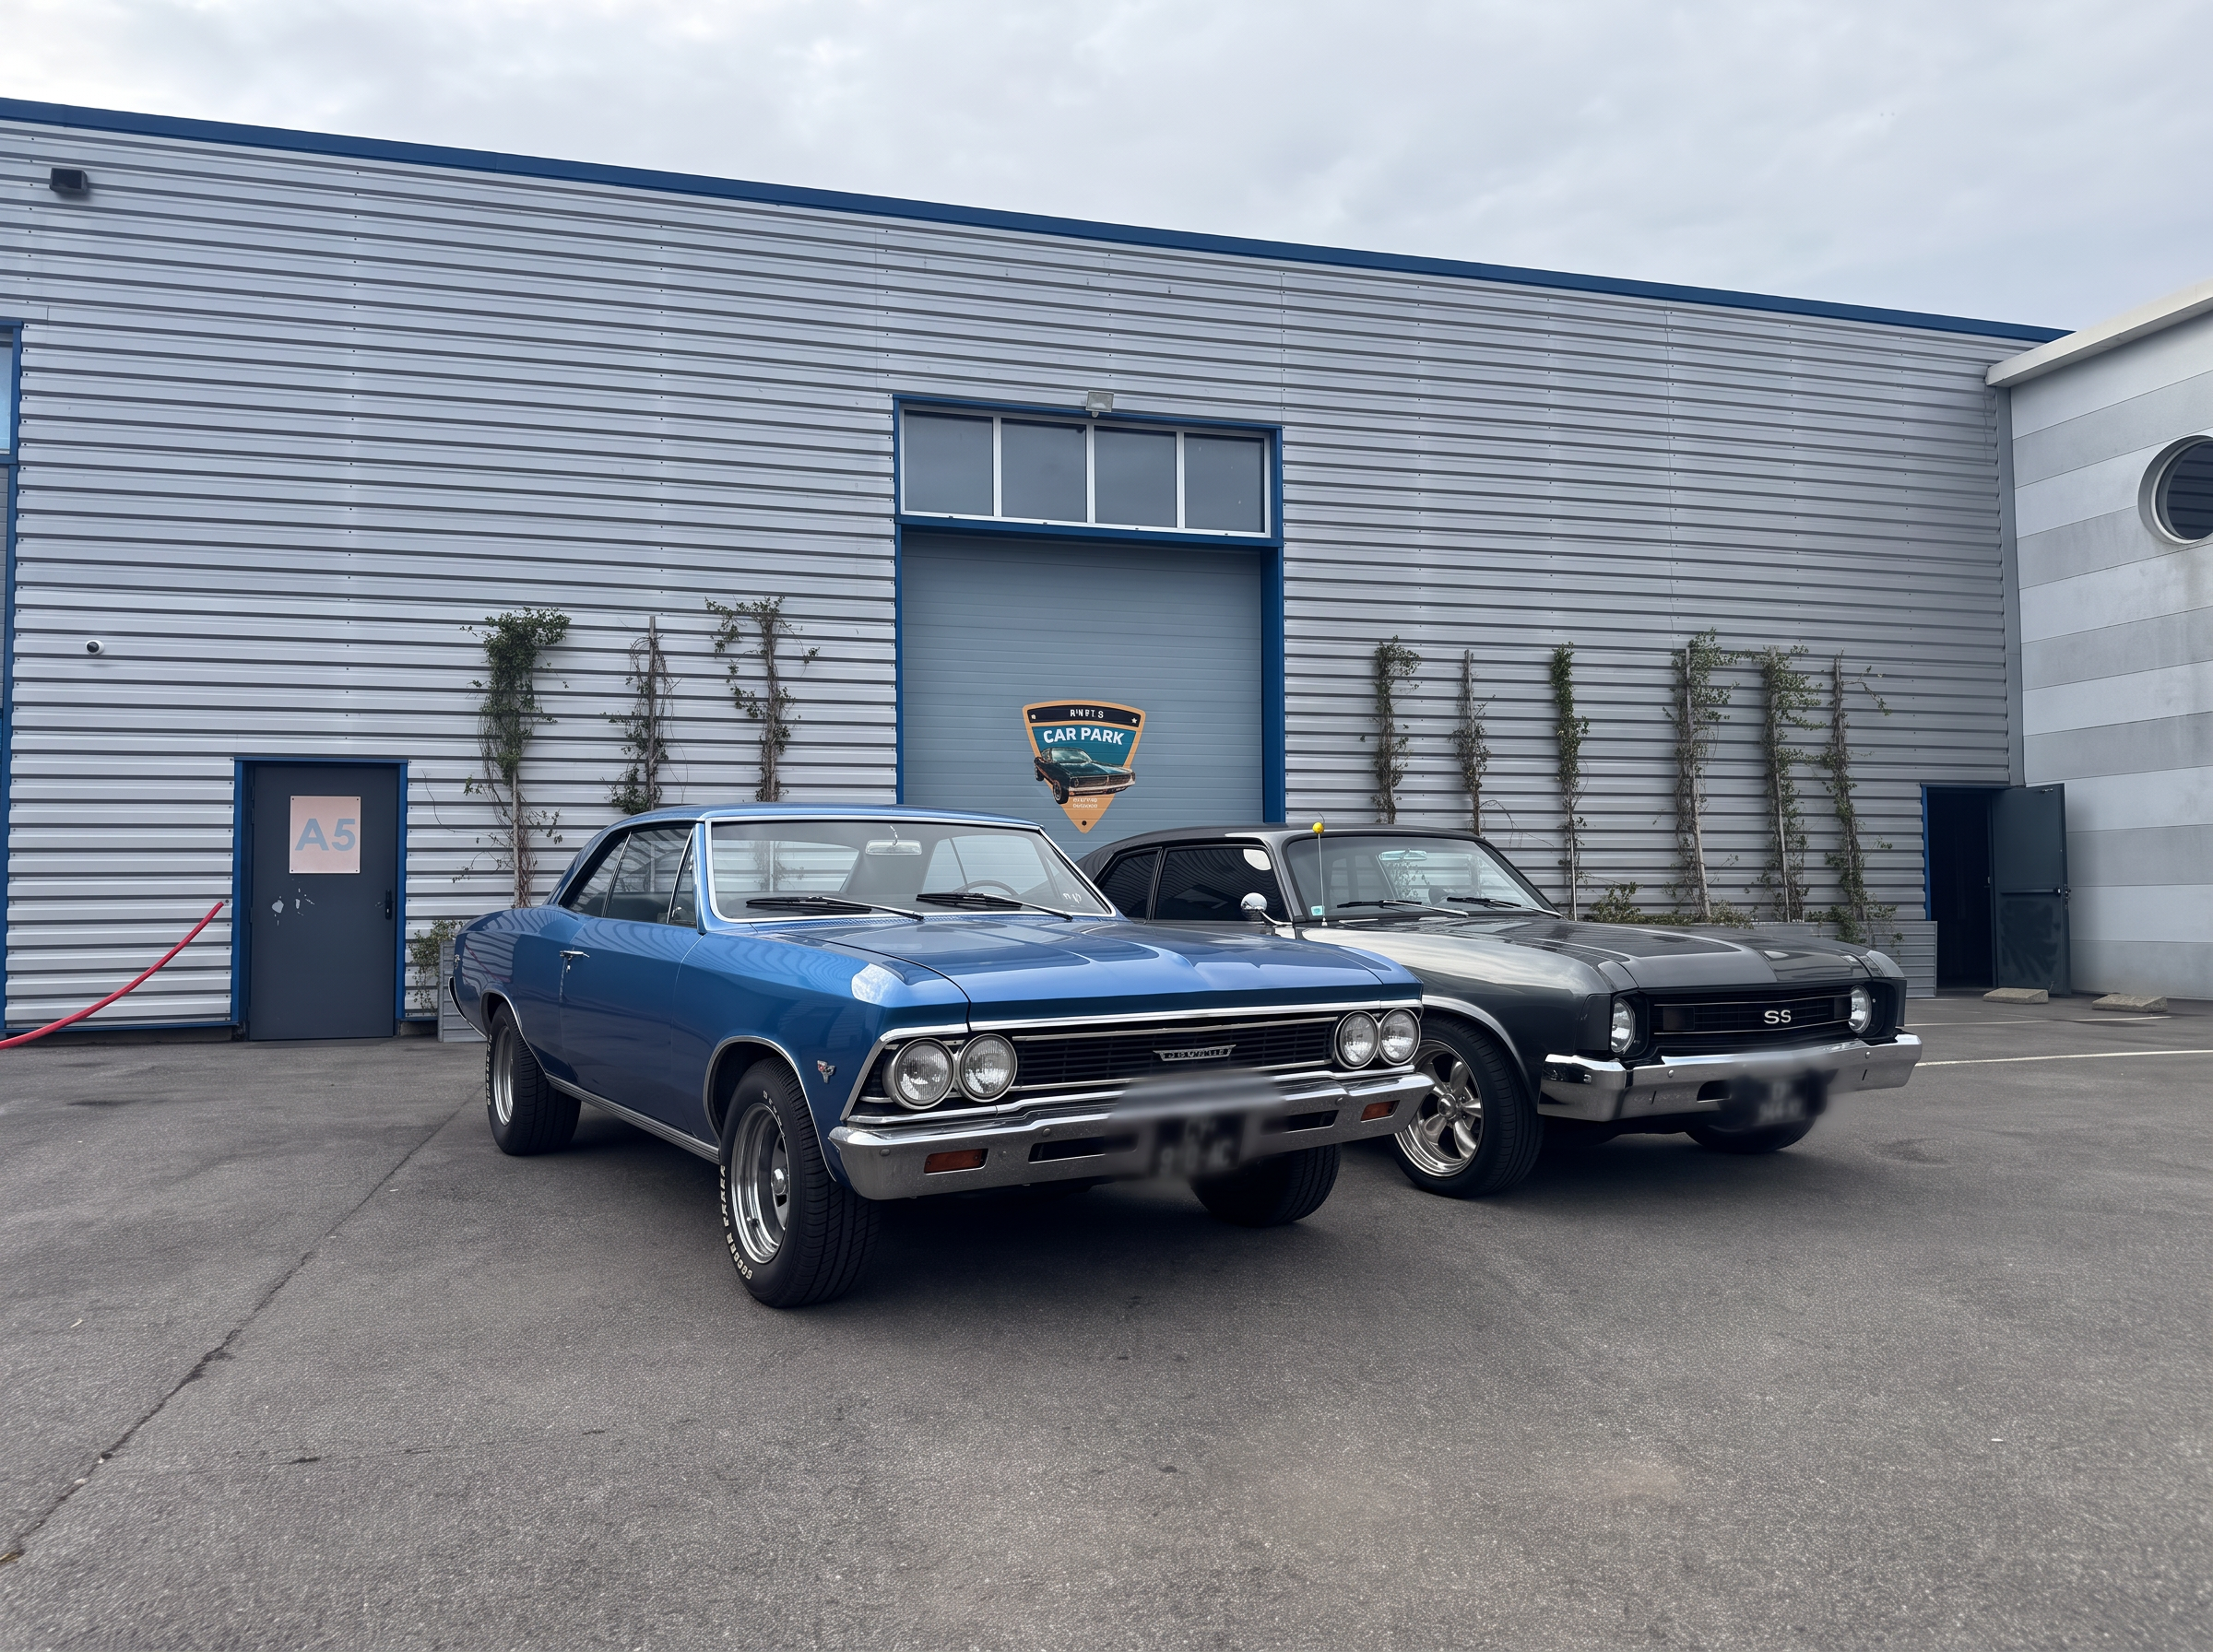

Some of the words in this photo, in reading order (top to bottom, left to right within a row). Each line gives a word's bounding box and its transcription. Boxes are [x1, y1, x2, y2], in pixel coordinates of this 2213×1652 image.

[1043, 727, 1077, 744] CAR
[1081, 726, 1125, 745] PARK
[295, 818, 356, 852] A5
[1763, 1009, 1792, 1024] SS
